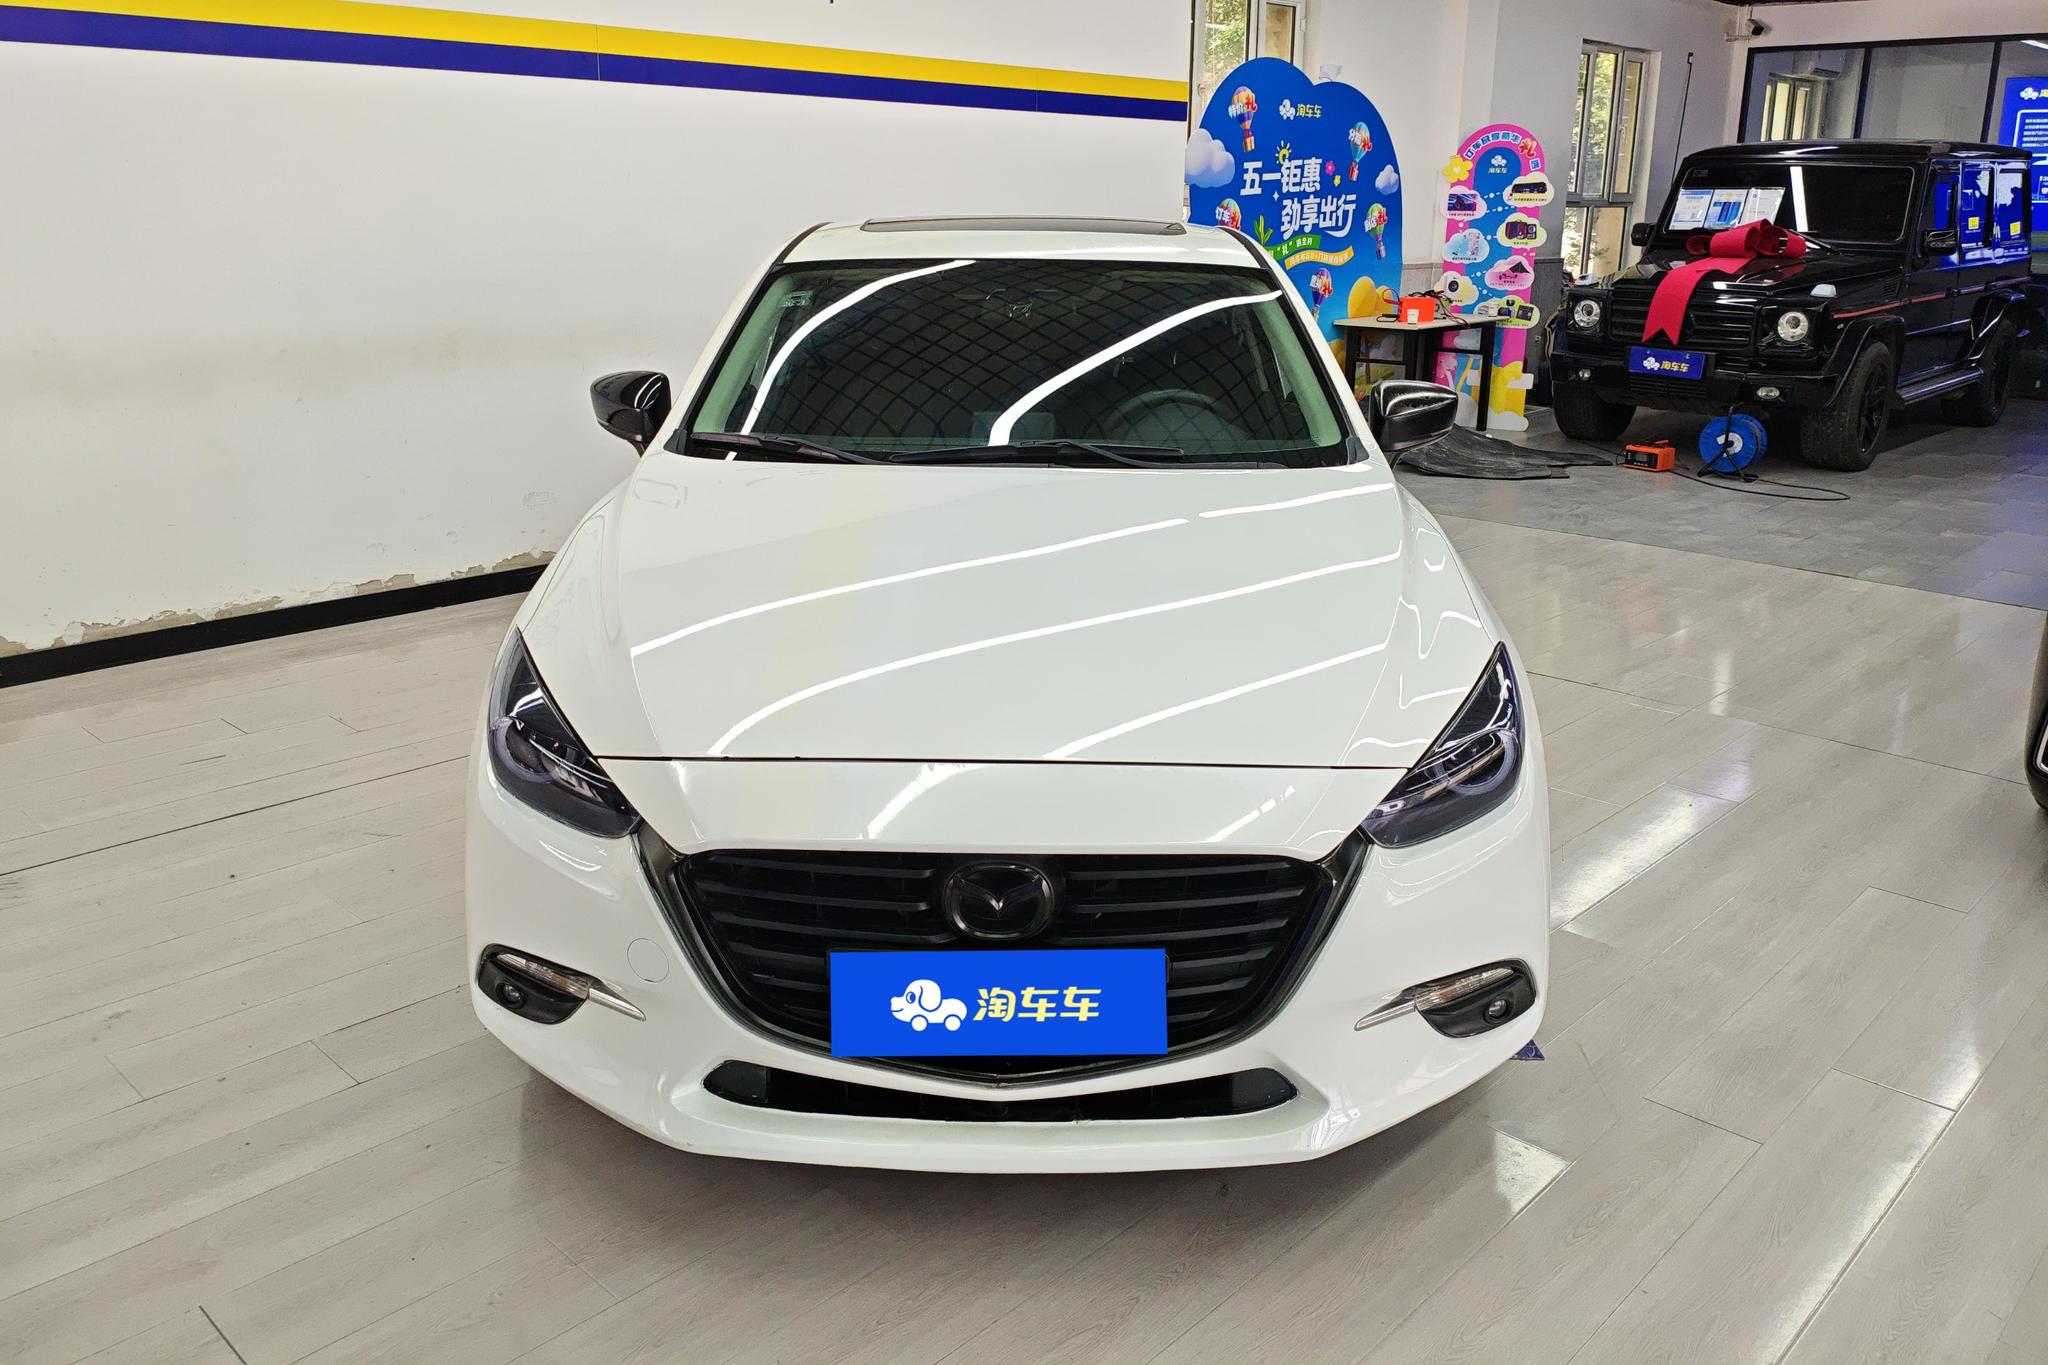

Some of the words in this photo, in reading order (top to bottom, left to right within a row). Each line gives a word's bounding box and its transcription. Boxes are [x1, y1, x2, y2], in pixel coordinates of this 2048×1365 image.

[1296, 103, 1322, 118] 淘车车
[1240, 157, 1322, 196] 五一钜惠
[1280, 194, 1357, 241] 劲享出行
[1660, 360, 1690, 373] 淘车车
